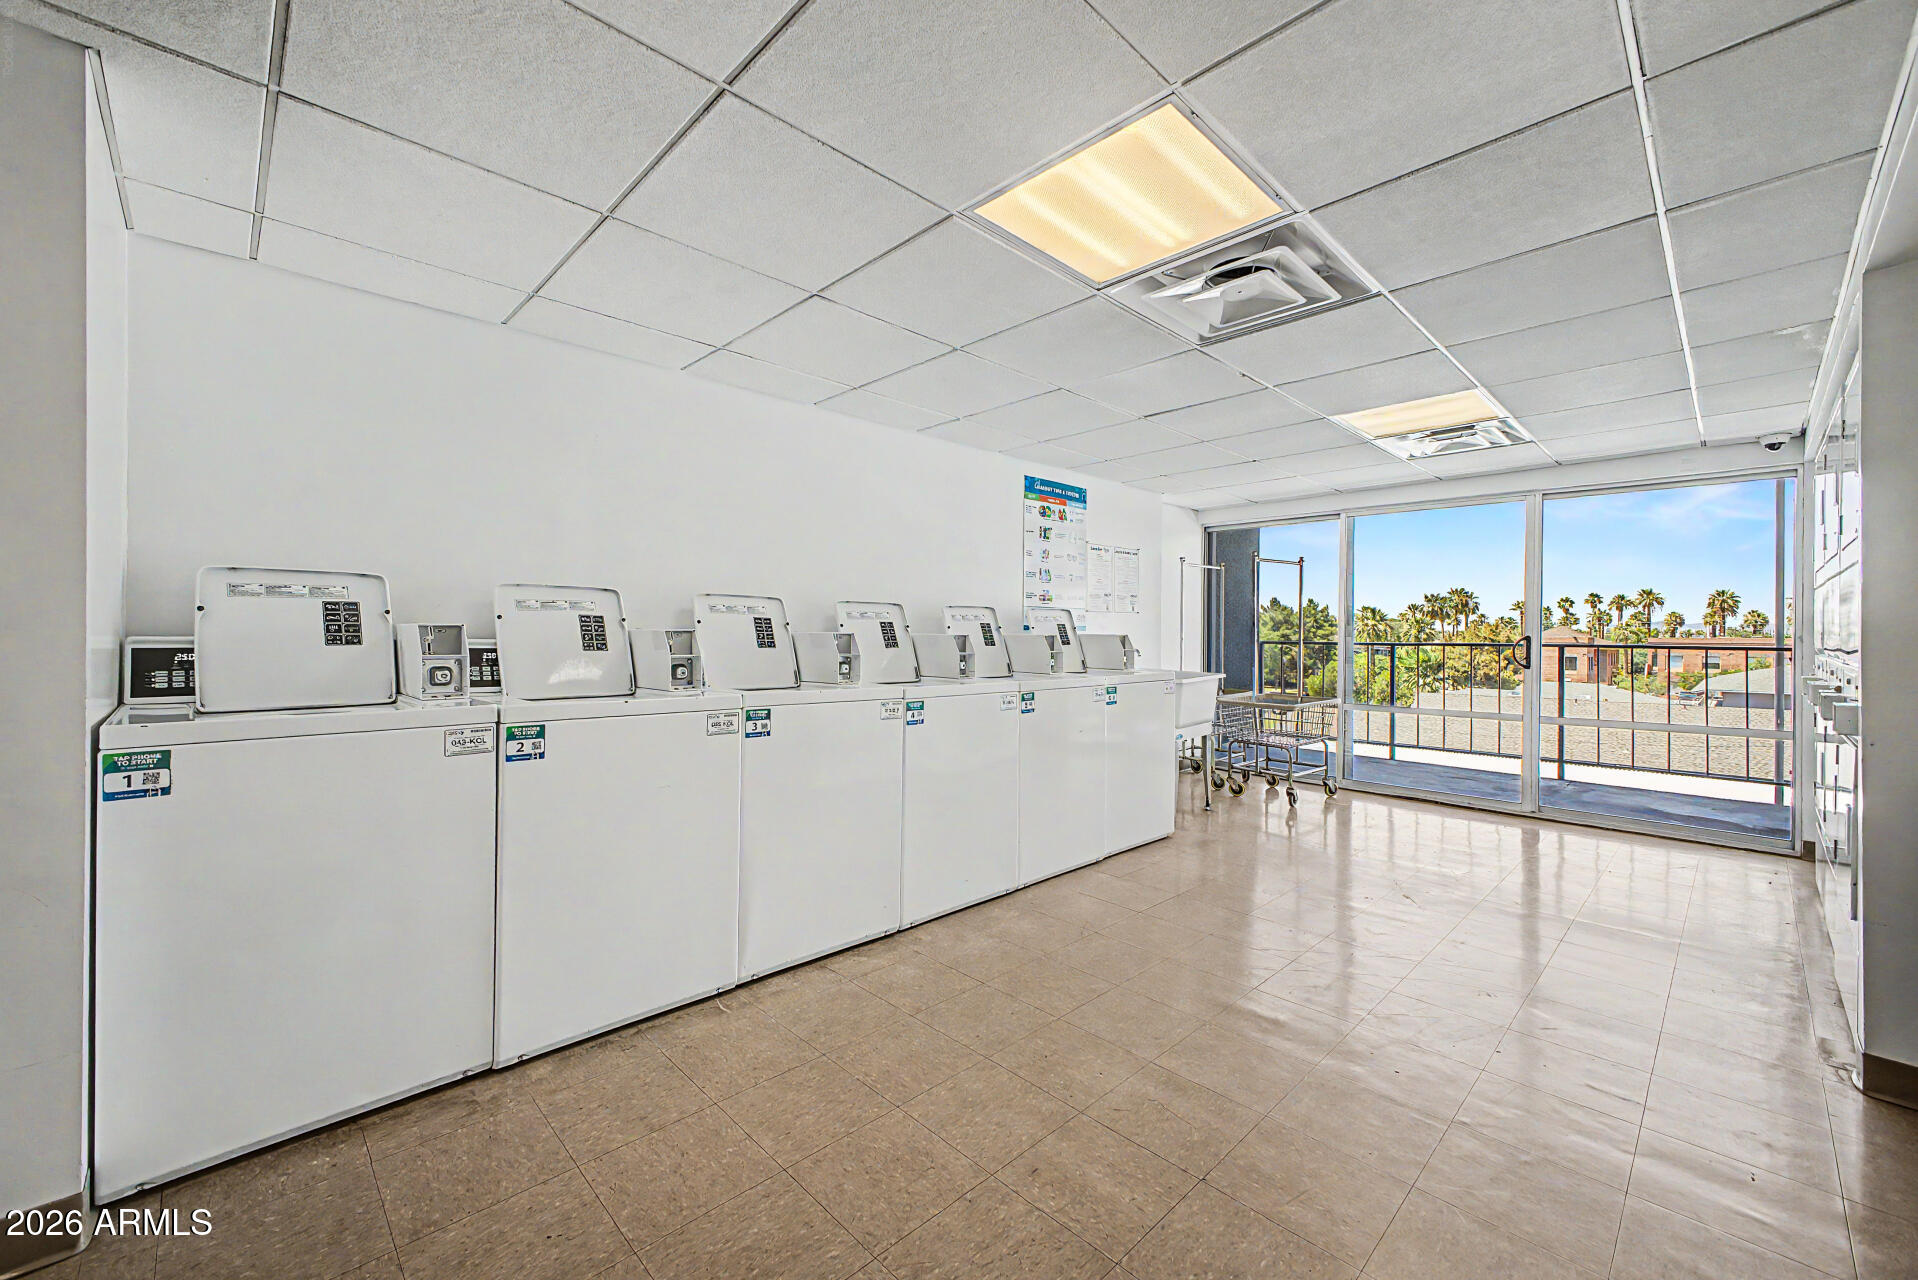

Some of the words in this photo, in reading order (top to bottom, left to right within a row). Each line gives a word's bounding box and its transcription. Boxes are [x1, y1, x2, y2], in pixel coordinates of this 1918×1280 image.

[752, 722, 757, 731] 3
[516, 742, 524, 752] 2
[131, 753, 162, 761] PHONE
[130, 758, 158, 766] START
[122, 775, 132, 788] 1
